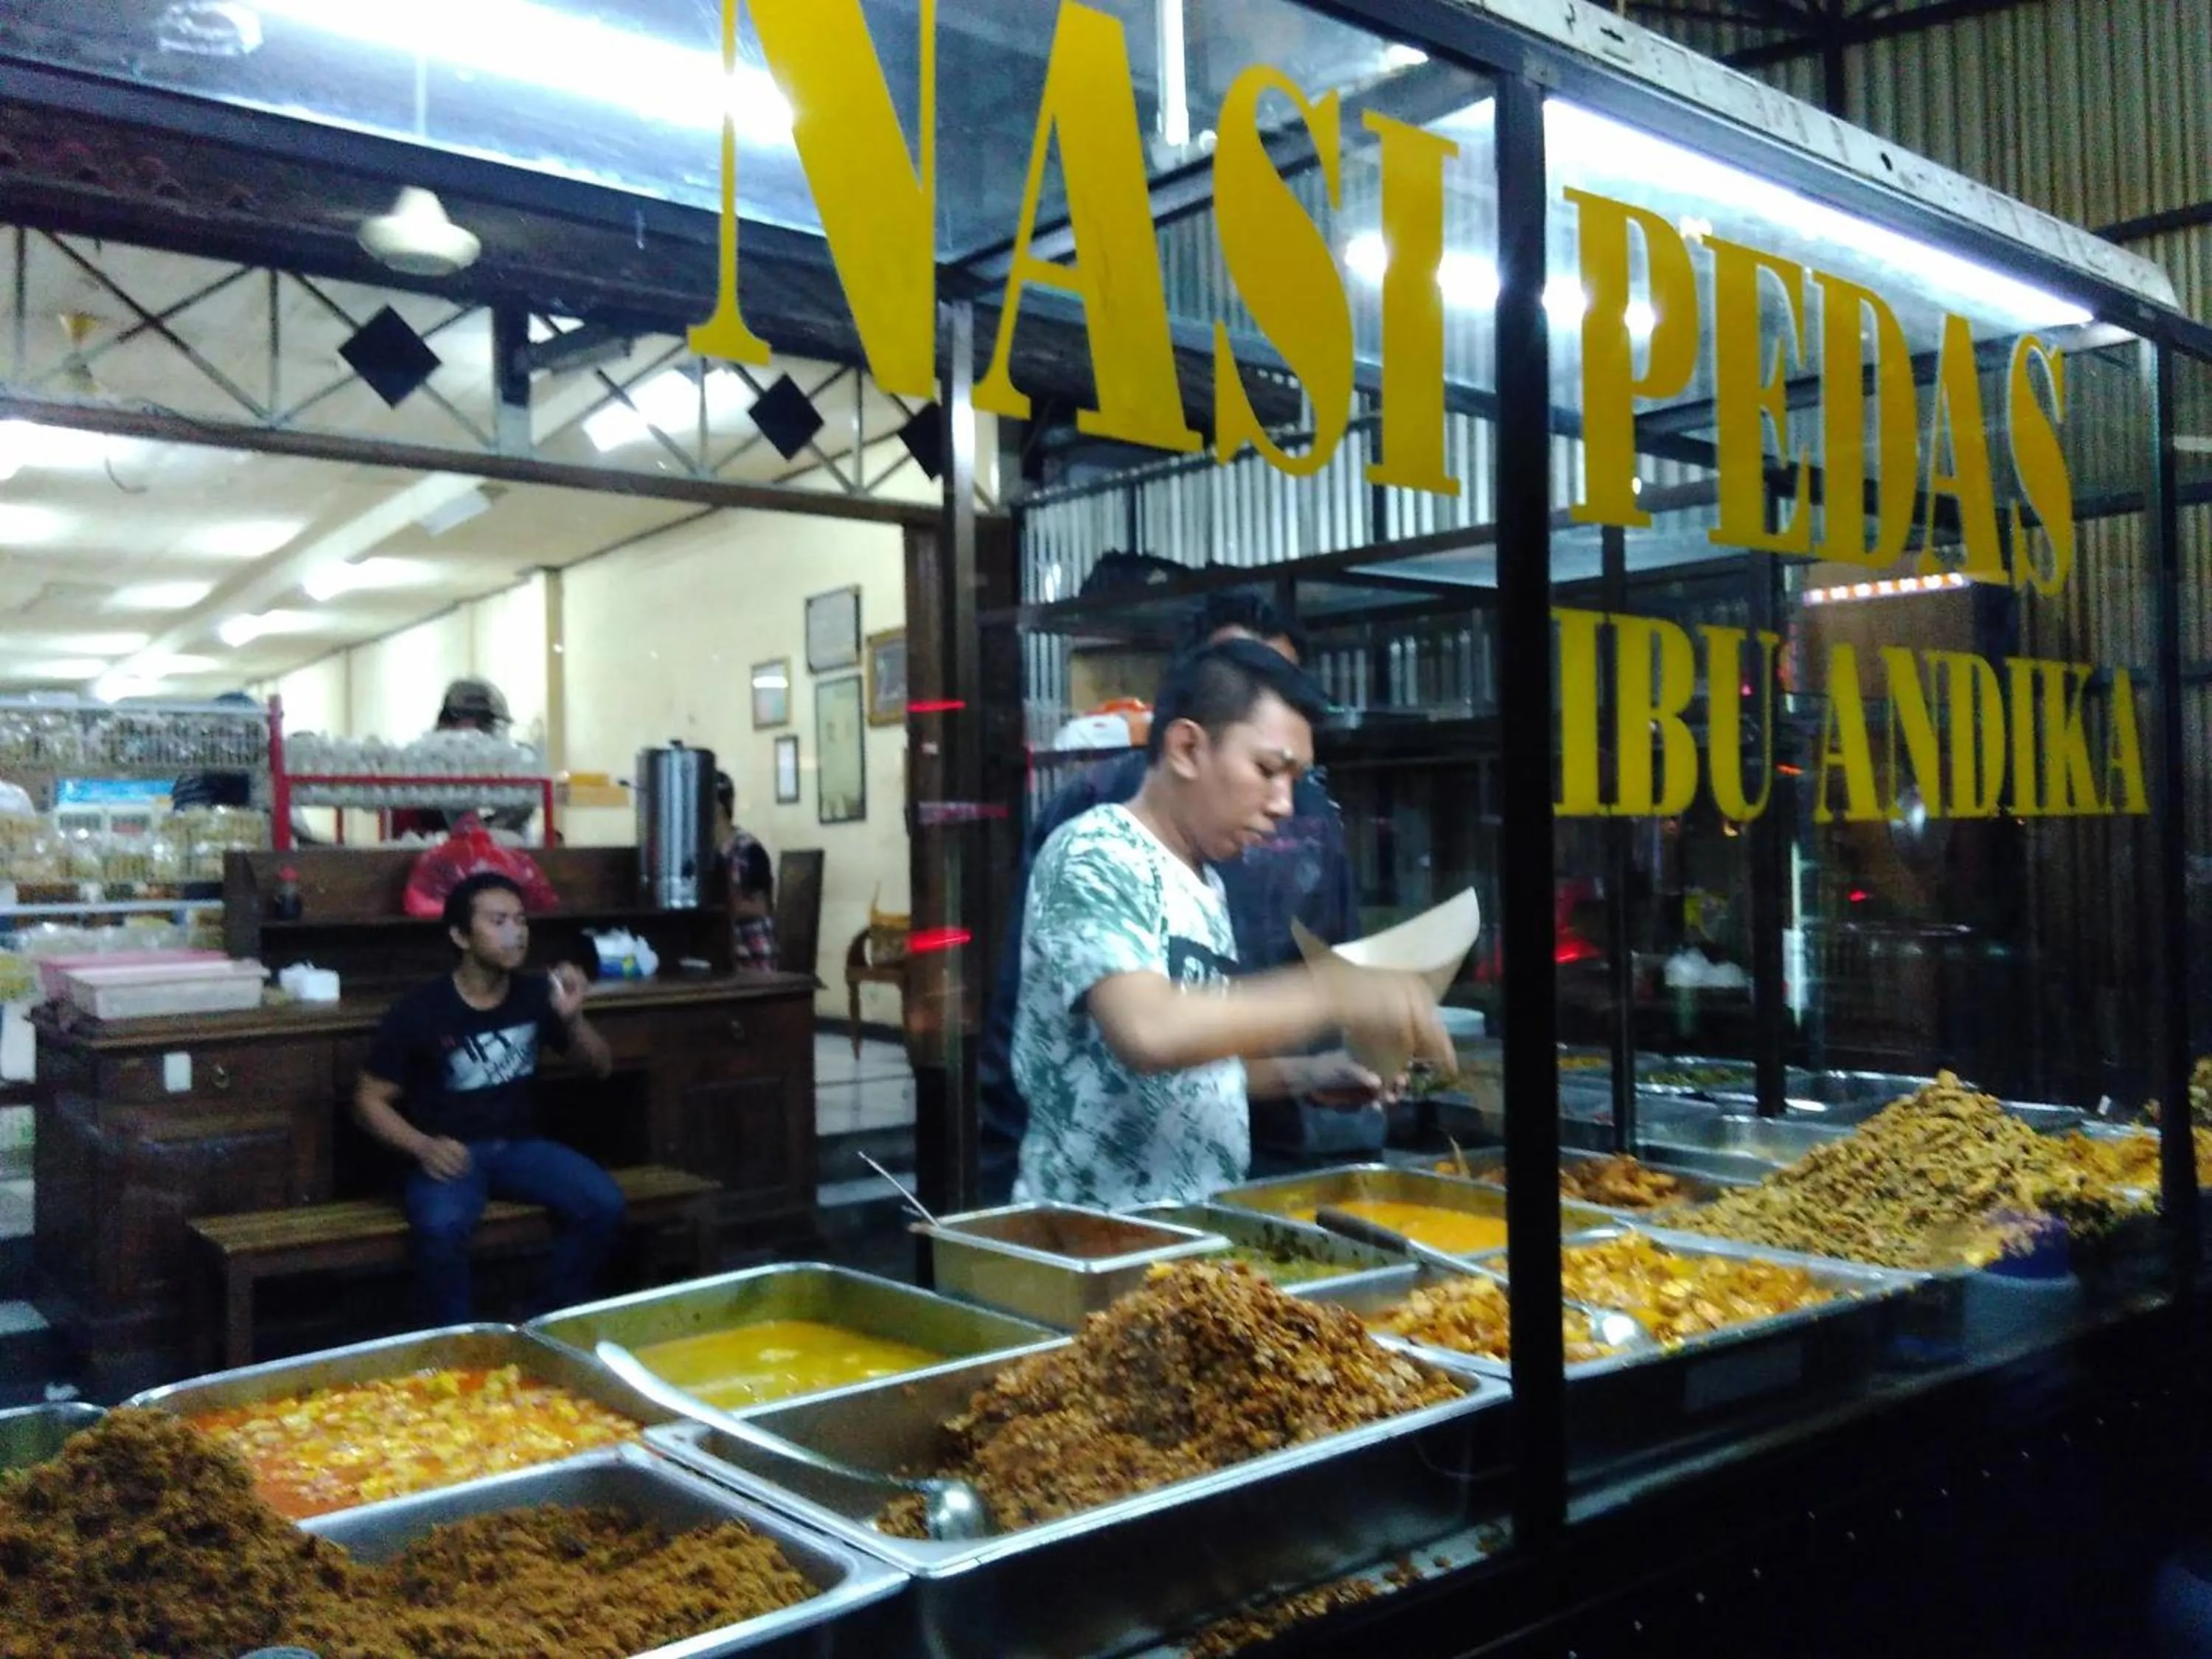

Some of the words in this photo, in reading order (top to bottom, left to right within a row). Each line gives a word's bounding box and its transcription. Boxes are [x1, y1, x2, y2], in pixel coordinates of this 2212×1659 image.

[686, 0, 1461, 496] NASI
[1563, 186, 2074, 596] PEDAS
[1551, 607, 1780, 821] IBU
[1814, 644, 2149, 822] ANDIKA
